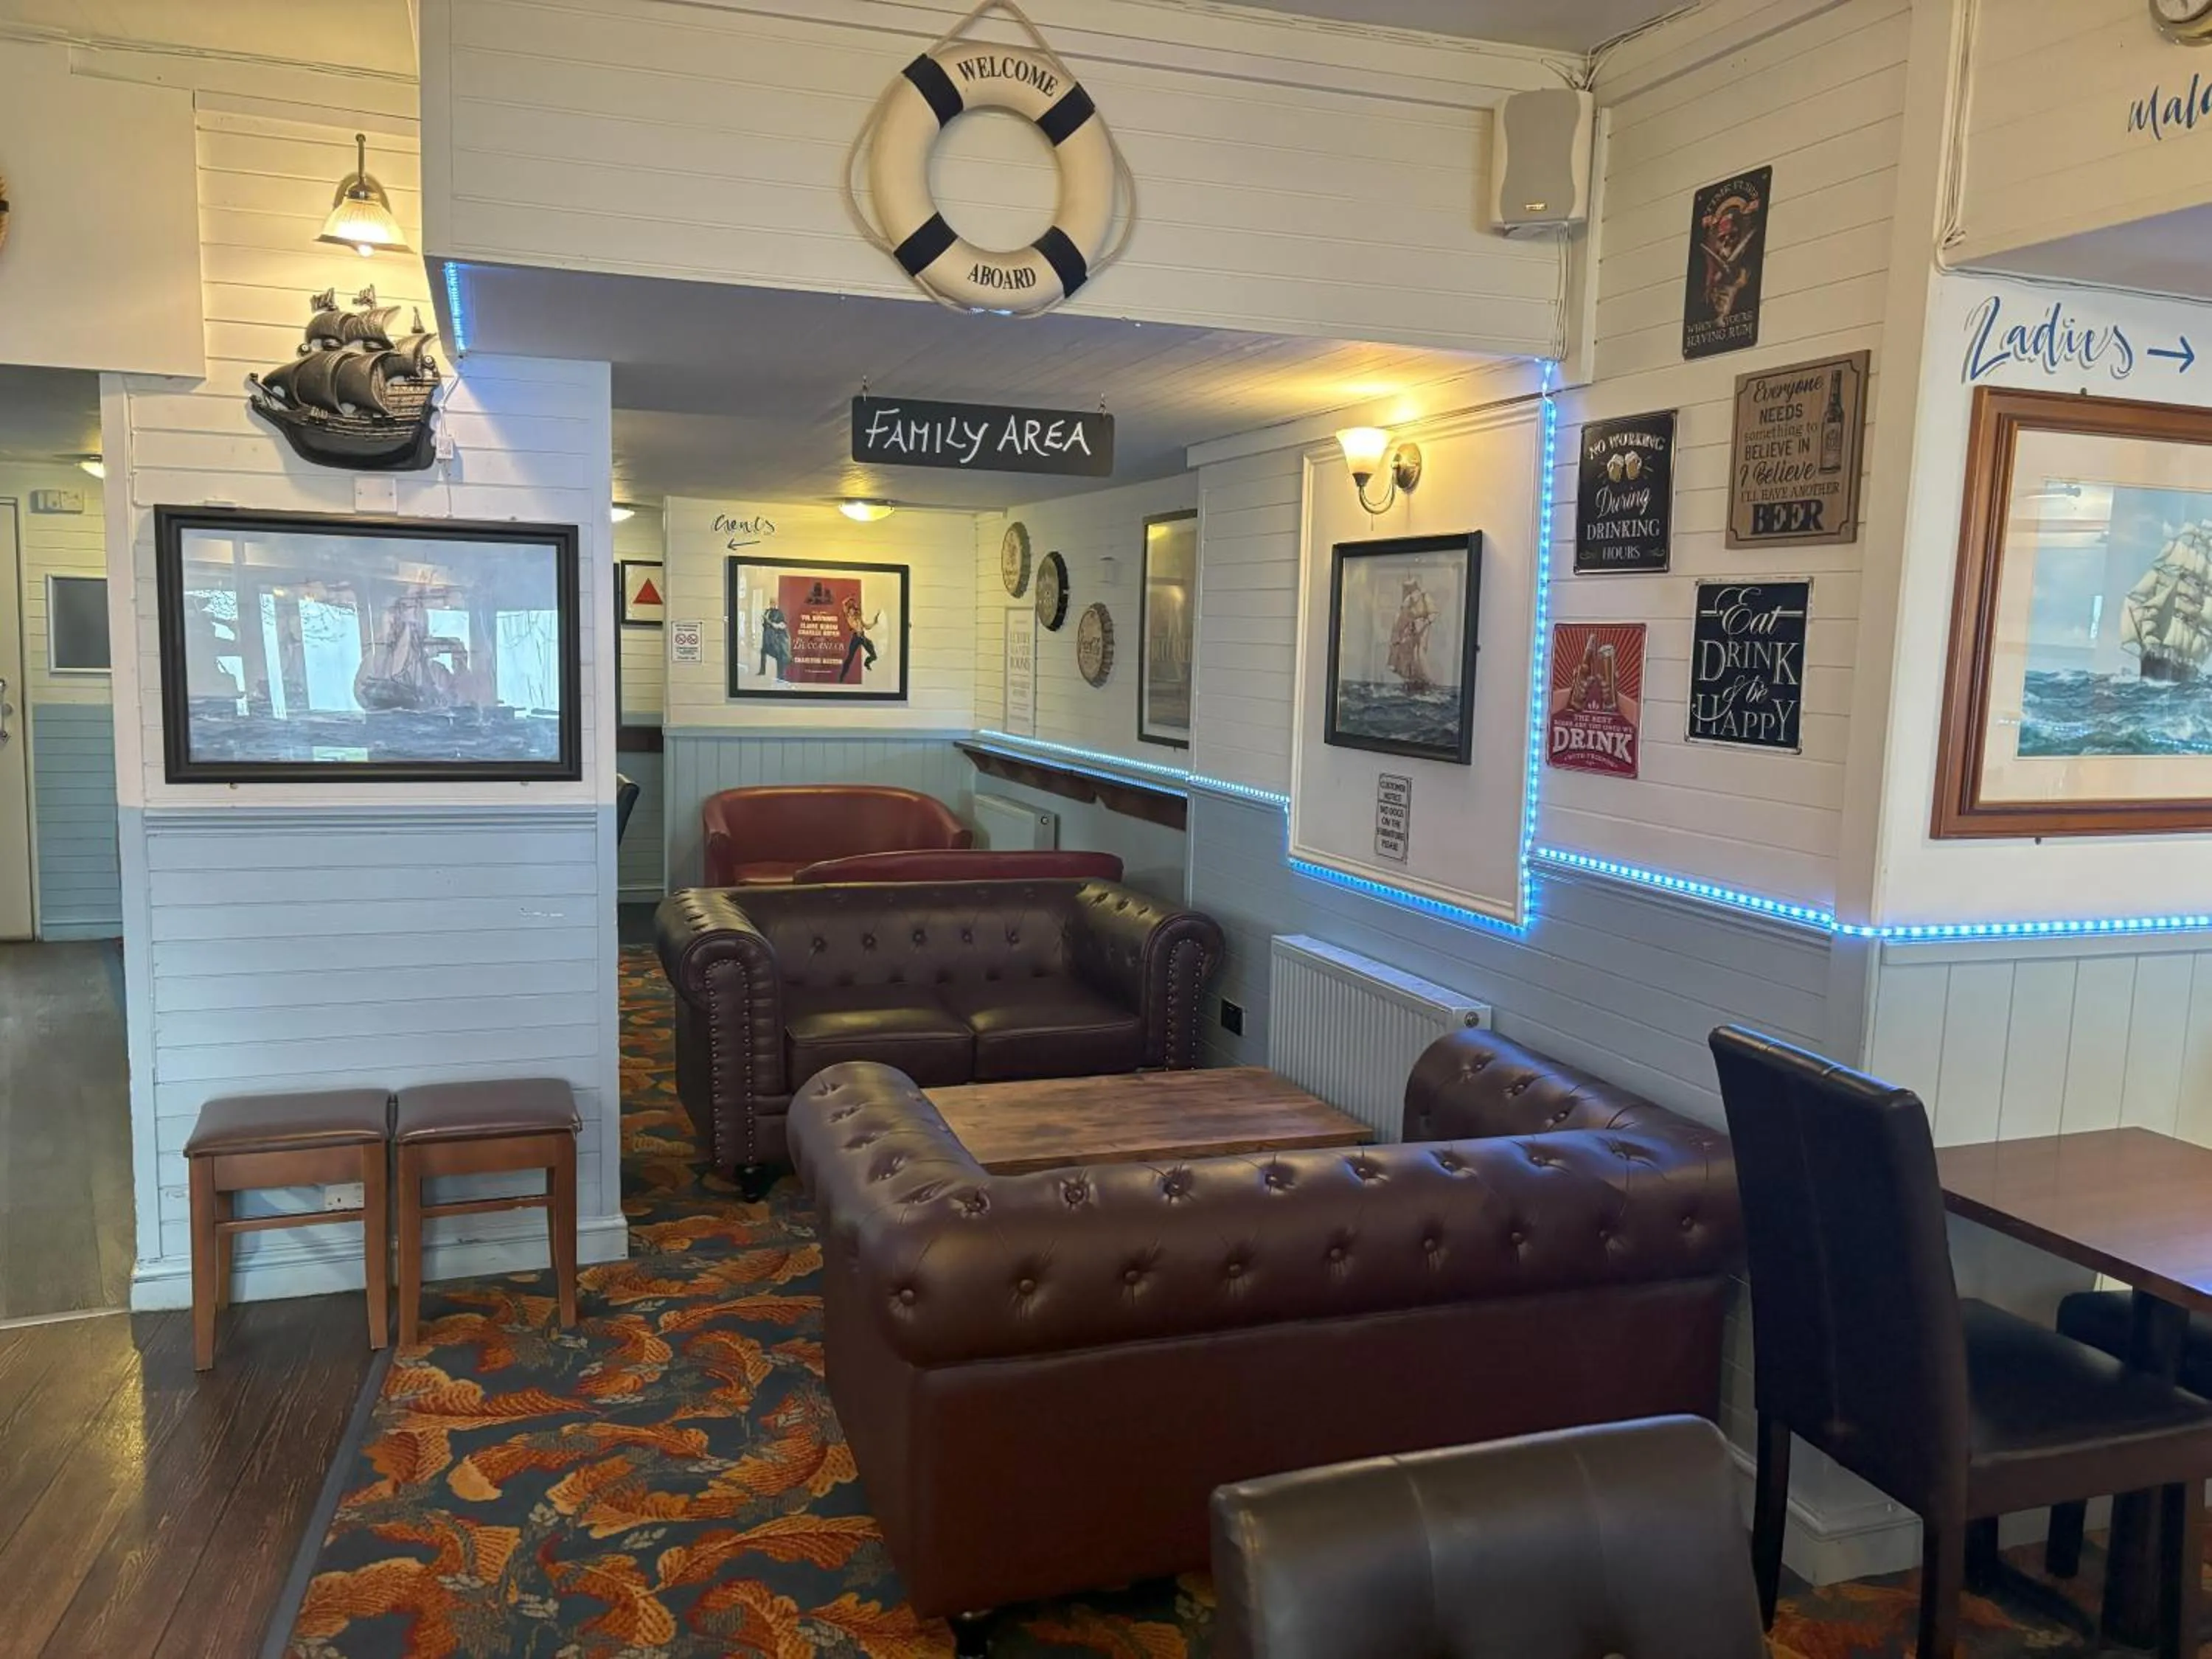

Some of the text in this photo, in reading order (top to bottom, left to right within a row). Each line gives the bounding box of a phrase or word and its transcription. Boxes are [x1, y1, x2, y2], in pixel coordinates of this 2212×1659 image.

[957, 57, 1059, 97] WELCOME
[967, 263, 1037, 290] ABOARD
[1962, 296, 2134, 385] Ladies
[1753, 375, 1823, 403] Everyone
[1759, 403, 1803, 425] NEEDS
[865, 408, 1091, 464] FAMILY AREA
[1589, 432, 1666, 460] NO WORKING
[1744, 422, 1818, 442] something to
[1745, 437, 1810, 462] BELIEVE IN
[1753, 459, 1816, 485] Believe
[1596, 484, 1651, 518] During
[1761, 486, 1789, 501] HAVE
[1790, 481, 1840, 499] ANOTHER
[1586, 518, 1660, 541] DRINKING
[1750, 498, 1824, 535] BEER
[1601, 545, 1641, 560] HOURS
[1714, 585, 1783, 636] Eat
[1698, 639, 1799, 685] DRINK
[1573, 713, 1590, 722] THE
[1696, 693, 1798, 741] HAPPY
[1552, 726, 1632, 765] DRINK
